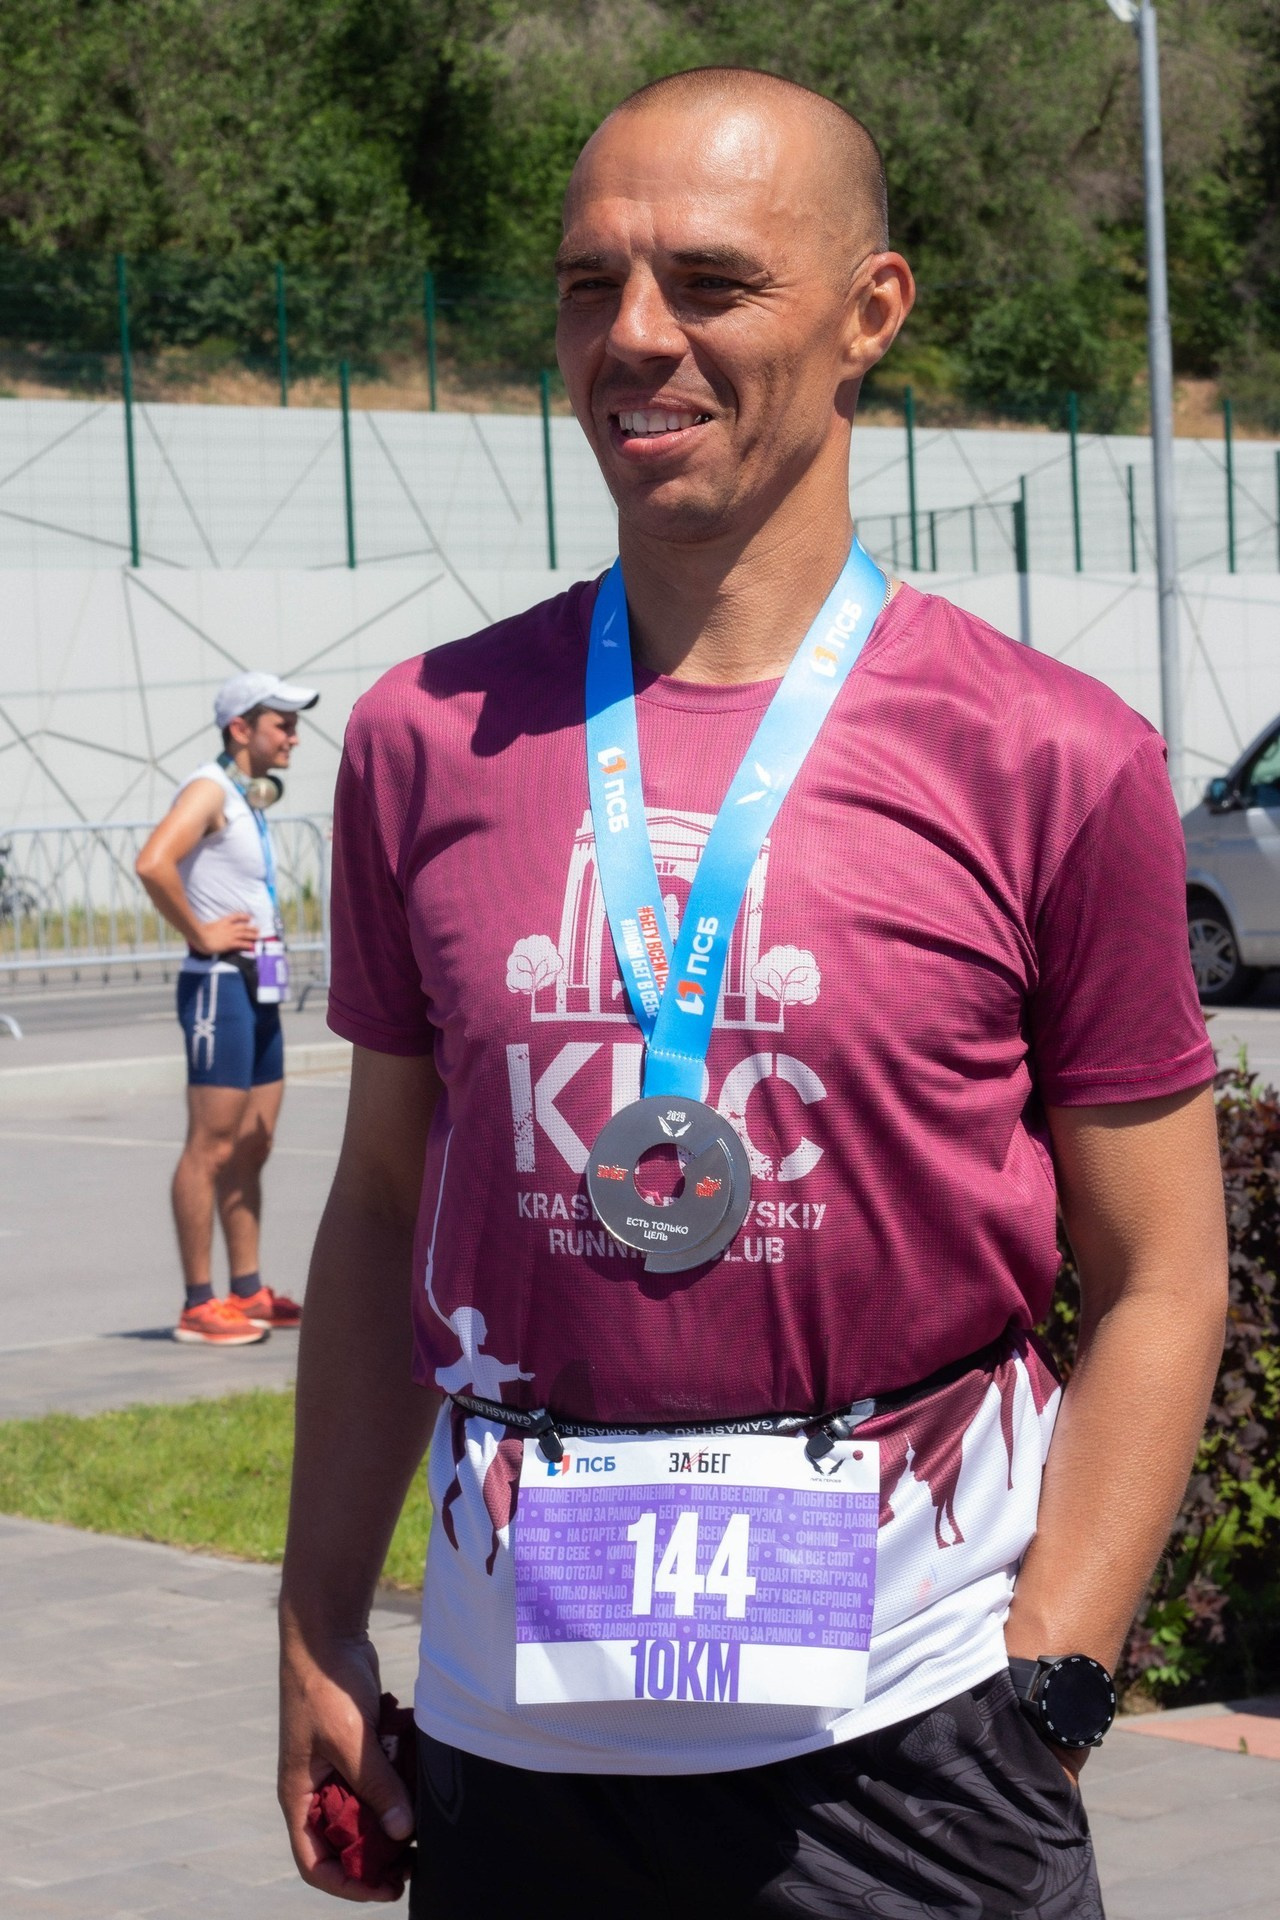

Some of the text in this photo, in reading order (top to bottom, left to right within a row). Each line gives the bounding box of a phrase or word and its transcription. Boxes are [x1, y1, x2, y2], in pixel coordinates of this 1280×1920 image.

[825, 599, 863, 649] ПСБ
[604, 778, 630, 833] ПСБ
[686, 916, 719, 976] ПСБ
[626, 1217, 689, 1235] ЕСТЬ ТОЛЬКО
[644, 1230, 668, 1241] ЦЕЛЬ
[576, 1455, 616, 1474] ПСБ
[528, 1487, 592, 1503] КИЛОМЕТРЫ
[691, 1486, 770, 1503] ПОКА ВСЕ СПЯТ
[792, 1491, 825, 1508] ЛЮБИ
[825, 1492, 845, 1509] БЕГ
[846, 1494, 856, 1509] В
[544, 1506, 641, 1523] ВЫБЕГАЮ ЗА РАМКИ
[802, 1511, 843, 1527] СТРЕСС
[567, 1528, 580, 1542] НА
[581, 1527, 618, 1542] СТАРТЕ
[796, 1531, 839, 1547] ФИНИШ
[540, 1546, 558, 1561] БЕГ
[558, 1546, 565, 1560] В
[566, 1546, 591, 1561] СЕБЕ
[776, 1548, 804, 1565] ПОКА
[805, 1550, 827, 1566] ВСЕ
[827, 1551, 855, 1567] СПЯТ
[531, 1565, 564, 1582] ДАВНО
[566, 1565, 603, 1580] ОТСТАЛ
[627, 1512, 757, 1618] 144
[749, 1566, 868, 1588] ЕГОВАЯ ПЕРЕЗАГРУЗКА
[549, 1586, 588, 1600] ТОЛЬКО
[589, 1585, 627, 1600] НАЧАЛО
[756, 1587, 862, 1609] БЕГУ ВСЕМ СЕРДЦЕМ
[556, 1604, 637, 1619] ЛЮБИ БЕГ В СЕБ
[829, 1611, 858, 1628] ПОКА
[566, 1622, 677, 1639] СТРЕСС ДАВНО ОТСТАЛ
[697, 1623, 802, 1644] ВЫБЕГАЮ ЗА РАМКИ
[822, 1630, 866, 1648] БЕГОВАЯ
